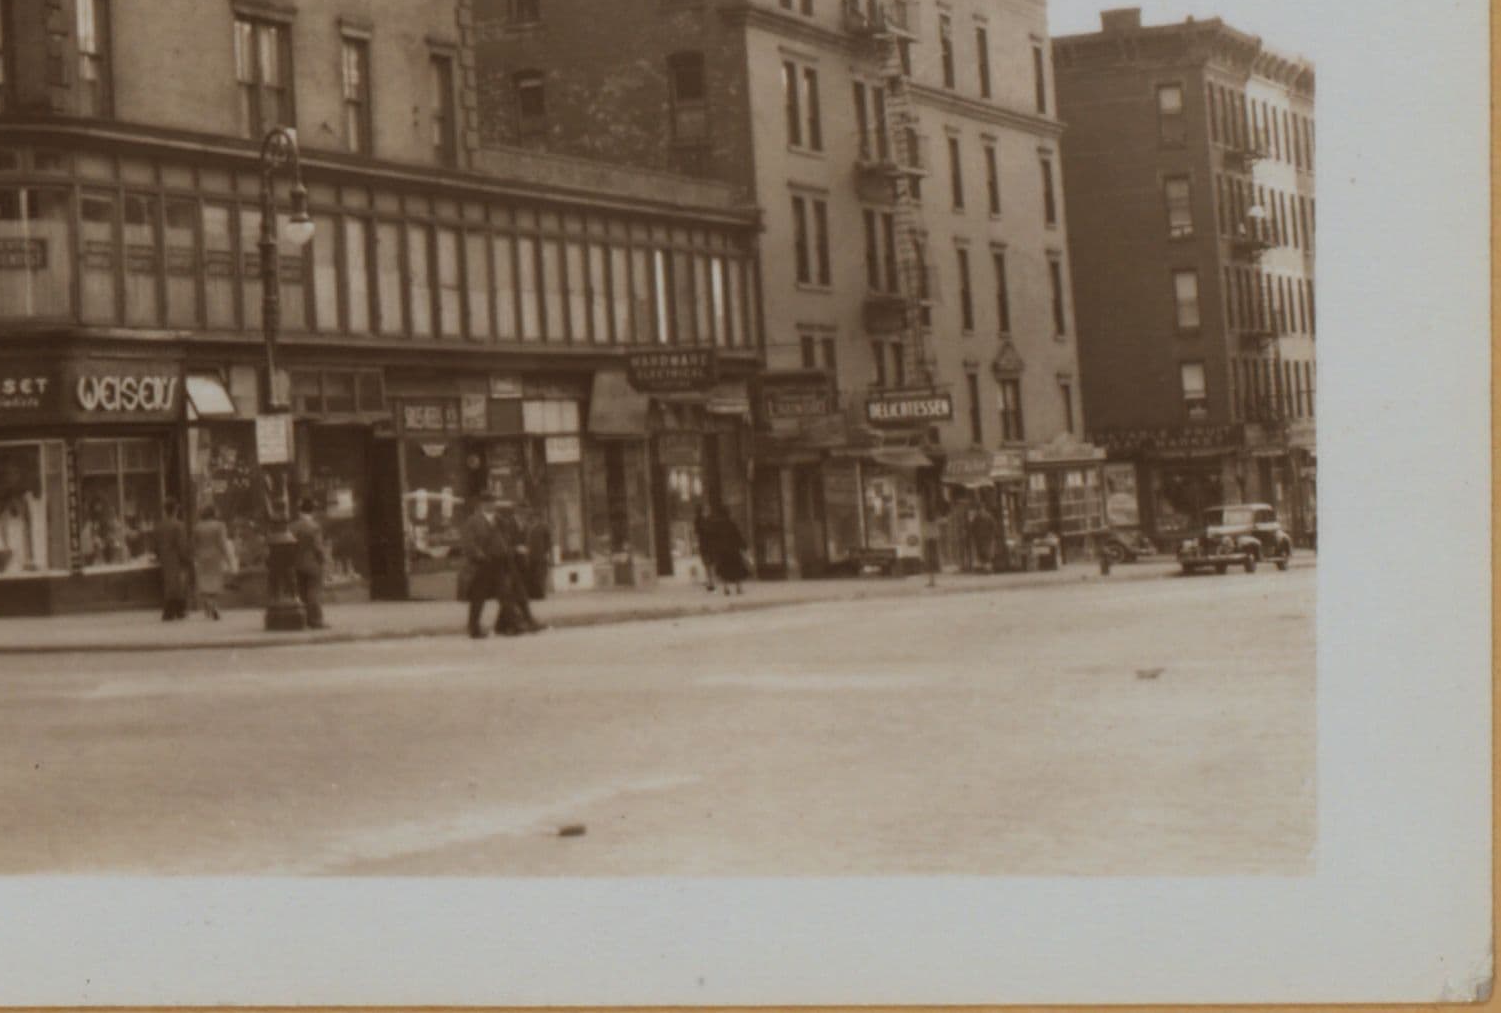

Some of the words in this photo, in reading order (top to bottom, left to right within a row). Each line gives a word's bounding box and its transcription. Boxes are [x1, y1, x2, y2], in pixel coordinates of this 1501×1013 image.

[630, 353, 708, 367] HARDWARE
[76, 375, 178, 412] WEISER'S
[868, 398, 950, 419] DELICATESSEN
